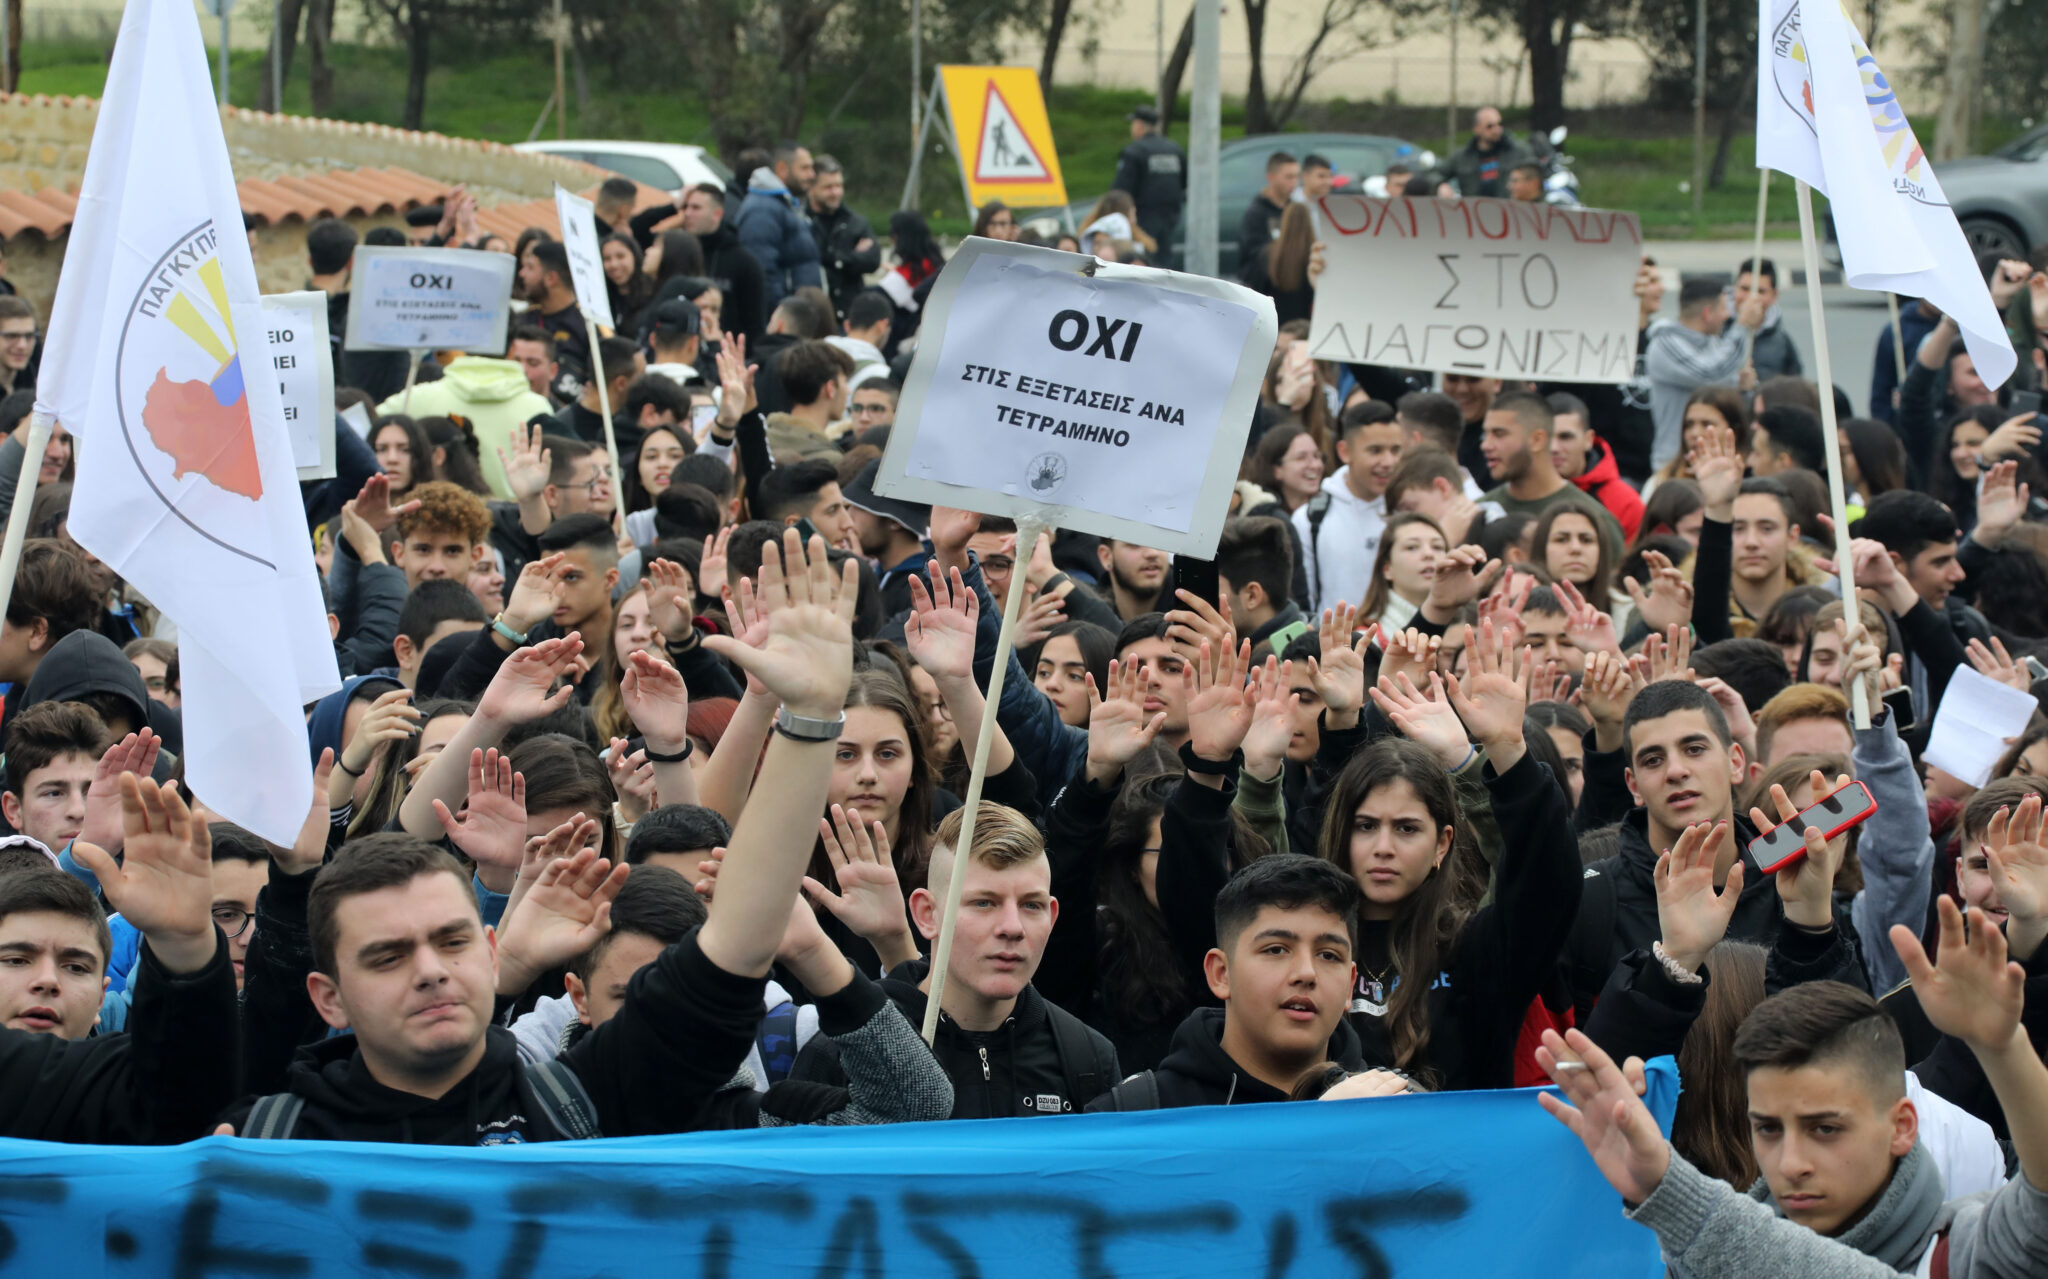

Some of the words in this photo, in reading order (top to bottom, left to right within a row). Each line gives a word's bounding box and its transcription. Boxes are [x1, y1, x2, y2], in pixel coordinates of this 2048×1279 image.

[1318, 197, 1418, 239] ΟΧΙ
[409, 273, 453, 291] ΟΧΙ
[1434, 253, 1559, 310] ΣΤΟ
[1048, 309, 1143, 363] ΟΧΙ
[1311, 321, 1634, 377] ΔΙΑΓΩΝΙΣΜΑ
[961, 364, 1012, 388] ΣΤΙΣ
[1016, 375, 1135, 415] ΕΞΕΤΑΣΕΙΣ
[1138, 401, 1185, 426] ΑΝΑ
[996, 404, 1131, 448] ΤΕΤΡΑΜΗΝΟ
